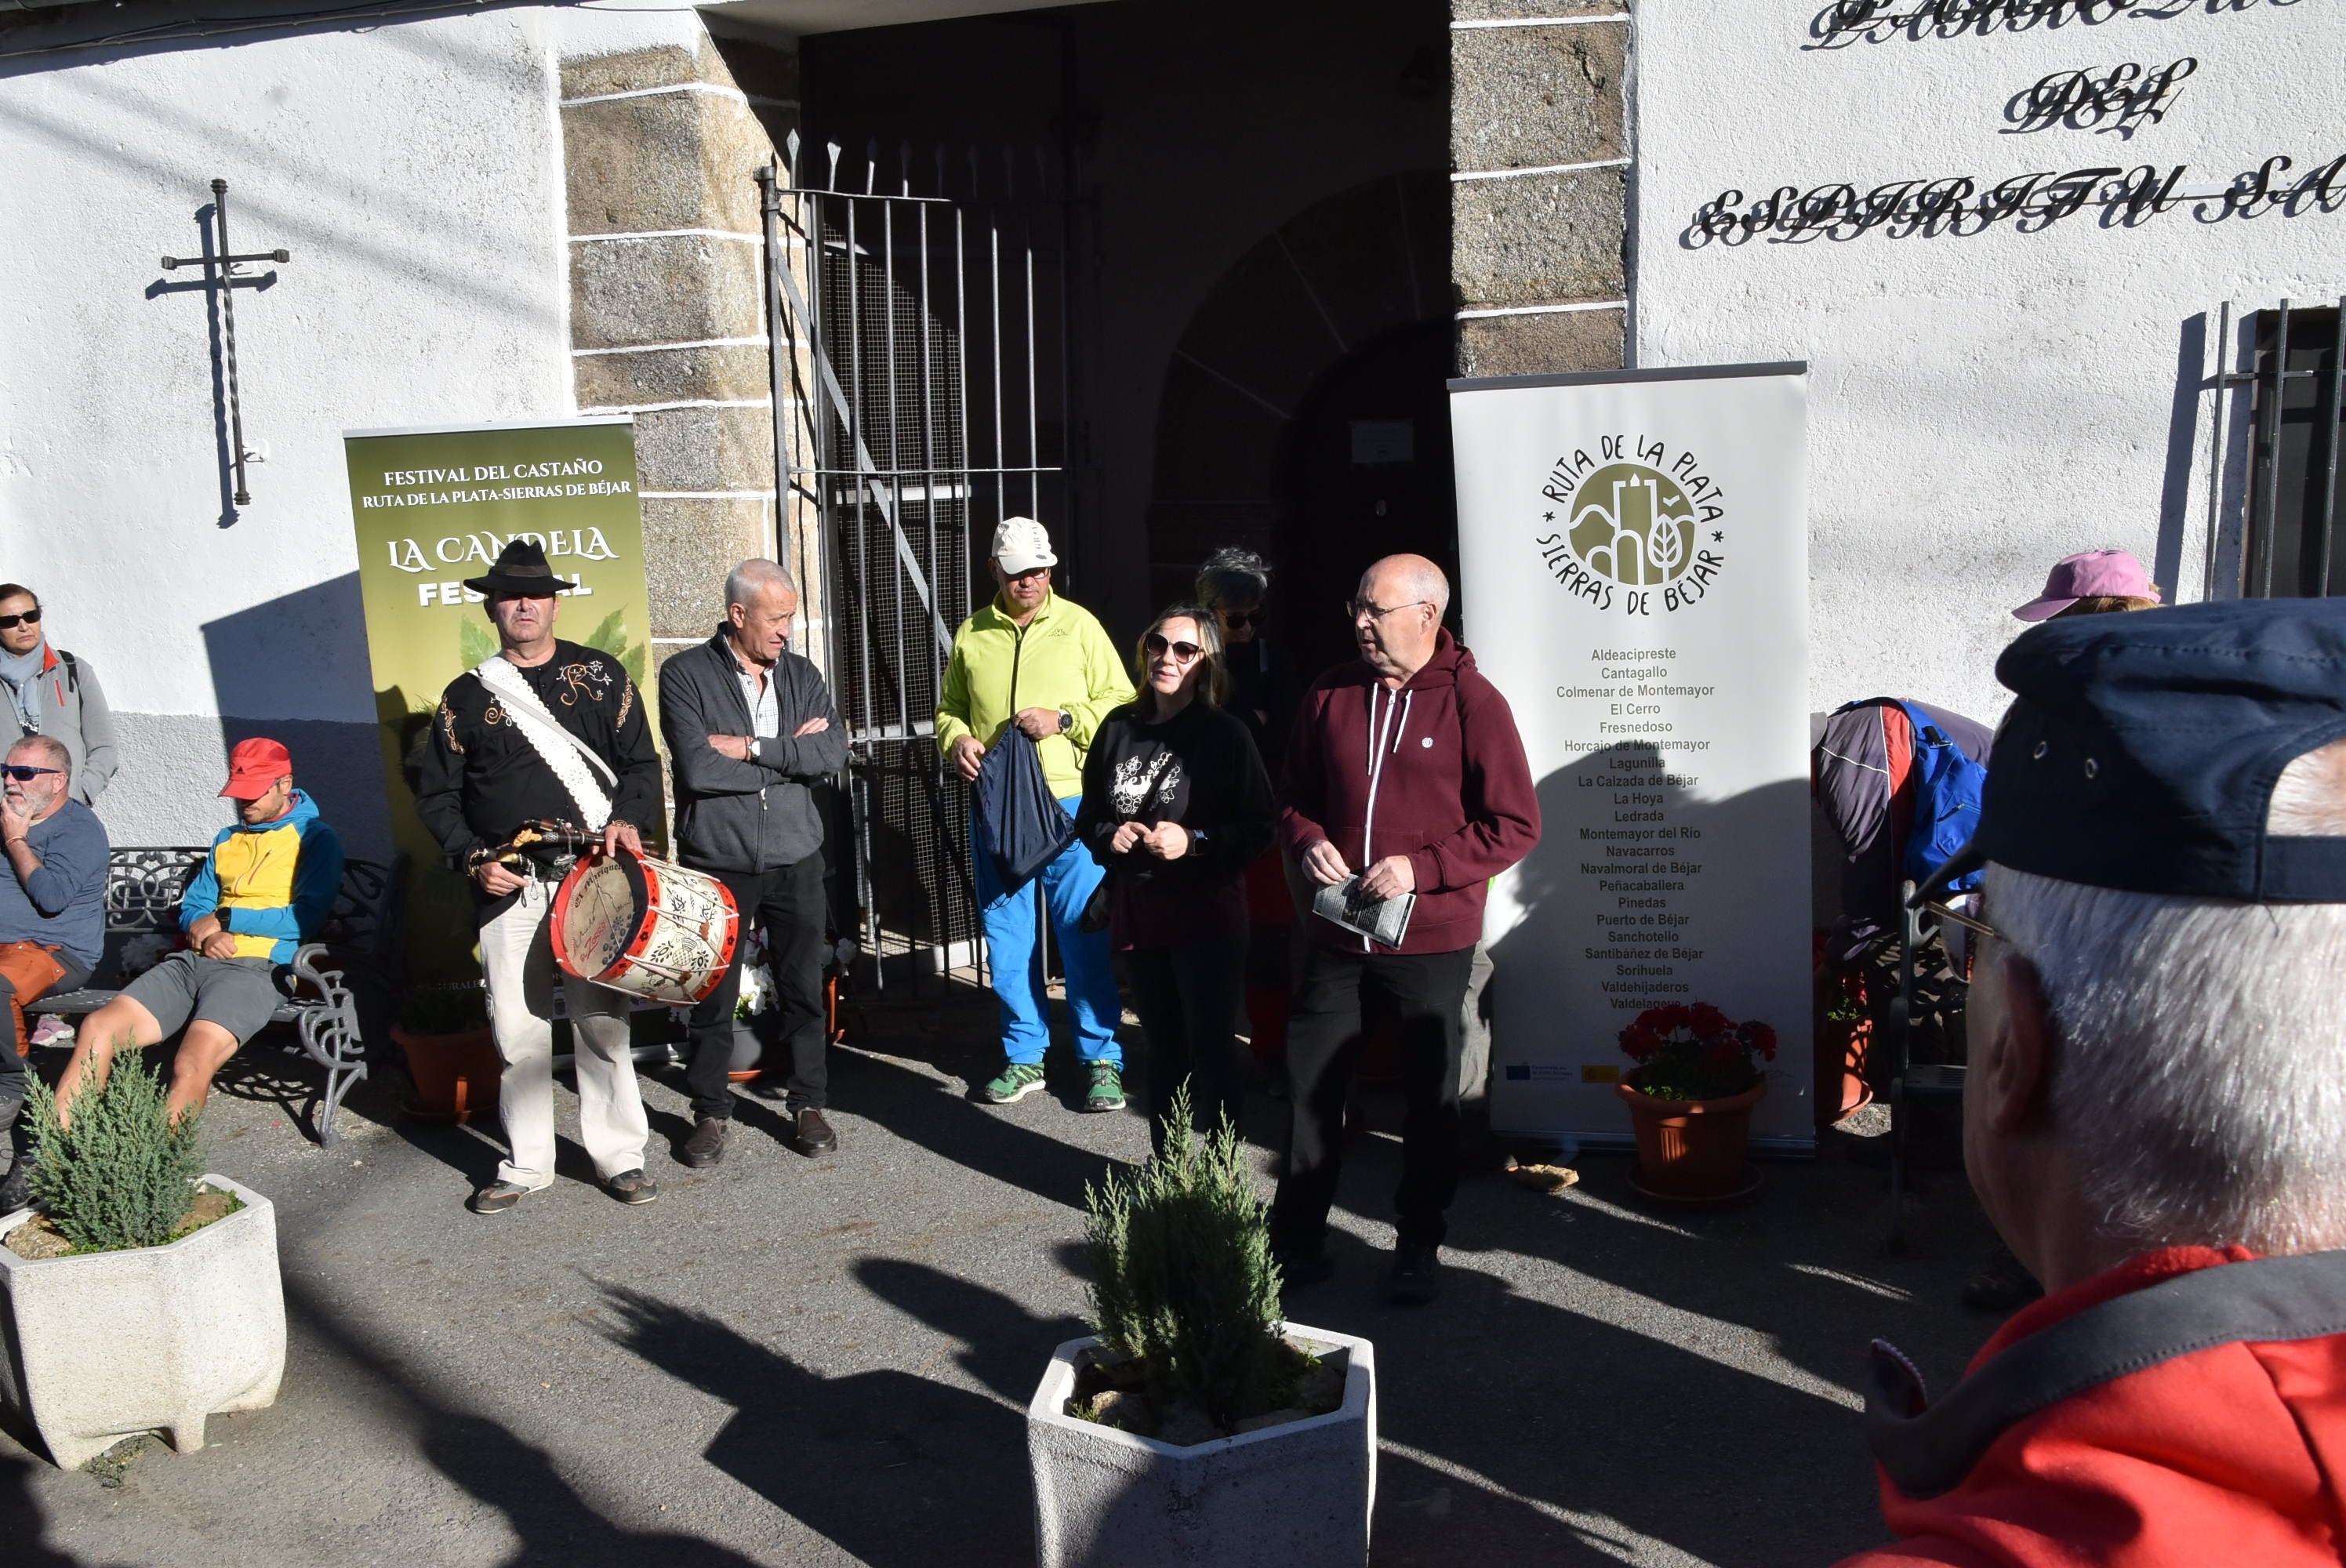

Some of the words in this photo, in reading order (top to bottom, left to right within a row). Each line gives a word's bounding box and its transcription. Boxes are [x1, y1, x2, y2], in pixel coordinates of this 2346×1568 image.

[2028, 57, 2198, 124] DEL
[1691, 165, 2188, 238] ESPIRITU
[384, 468, 470, 486] FESTIVAL
[474, 466, 510, 481] DEL
[514, 458, 603, 478] CASTAÑO
[1542, 449, 1595, 503] RUTA
[1601, 434, 1624, 460] DE
[1637, 434, 1665, 466] LA
[1672, 452, 1724, 523] PLATA
[362, 495, 405, 508] RUTA
[407, 493, 428, 506] DE
[430, 492, 450, 504] LA
[566, 483, 586, 495] DE
[589, 480, 632, 496] BÉJAR
[387, 538, 438, 573] LA
[1536, 534, 1614, 610] SIERRAS
[1628, 590, 1650, 615] DE
[1665, 550, 1724, 612] BÉJAR
[1591, 648, 1676, 662] Aldeacipreste
[1601, 666, 1668, 681] Cantagallo
[1556, 686, 1615, 698] Colmenar
[1618, 685, 1633, 696] de
[1637, 684, 1714, 699] Montemayor
[1611, 703, 1622, 715] El
[1626, 703, 1661, 714] Cerro
[1600, 721, 1672, 733] Fresnedoso
[1564, 740, 1611, 754] Horcajo
[1615, 739, 1629, 750] de
[1634, 739, 1710, 753] Montemayor
[1610, 757, 1665, 771] Lagunilla
[1578, 775, 1592, 787] La
[1596, 775, 1644, 787] Calzada
[1648, 775, 1662, 786] de
[1667, 774, 1698, 788] Béjar
[1614, 793, 1629, 804] La
[1632, 793, 1664, 806] Hoya
[1615, 810, 1664, 822] Ledrada
[1580, 828, 1655, 842] Montemayor
[1658, 827, 1676, 839] del
[1680, 826, 1701, 838] Río
[1607, 845, 1675, 857] Navacarros
[1581, 862, 1648, 874] Navalmoral
[1652, 862, 1666, 873] de
[1670, 862, 1702, 876] Béjar
[1600, 880, 1684, 891] Peñacaballera
[1618, 897, 1666, 909] Pinedas
[1596, 914, 1636, 926] Puerto
[1640, 914, 1654, 925] de
[1658, 913, 1690, 927] Béjar
[1608, 931, 1679, 942] Sanchotello
[1585, 948, 1651, 960] Santibáñez
[1654, 948, 1669, 959] de
[1672, 947, 1704, 961] Béjar
[1616, 964, 1673, 976] Sorihuela
[1601, 982, 1689, 994] Valdehijaderos
